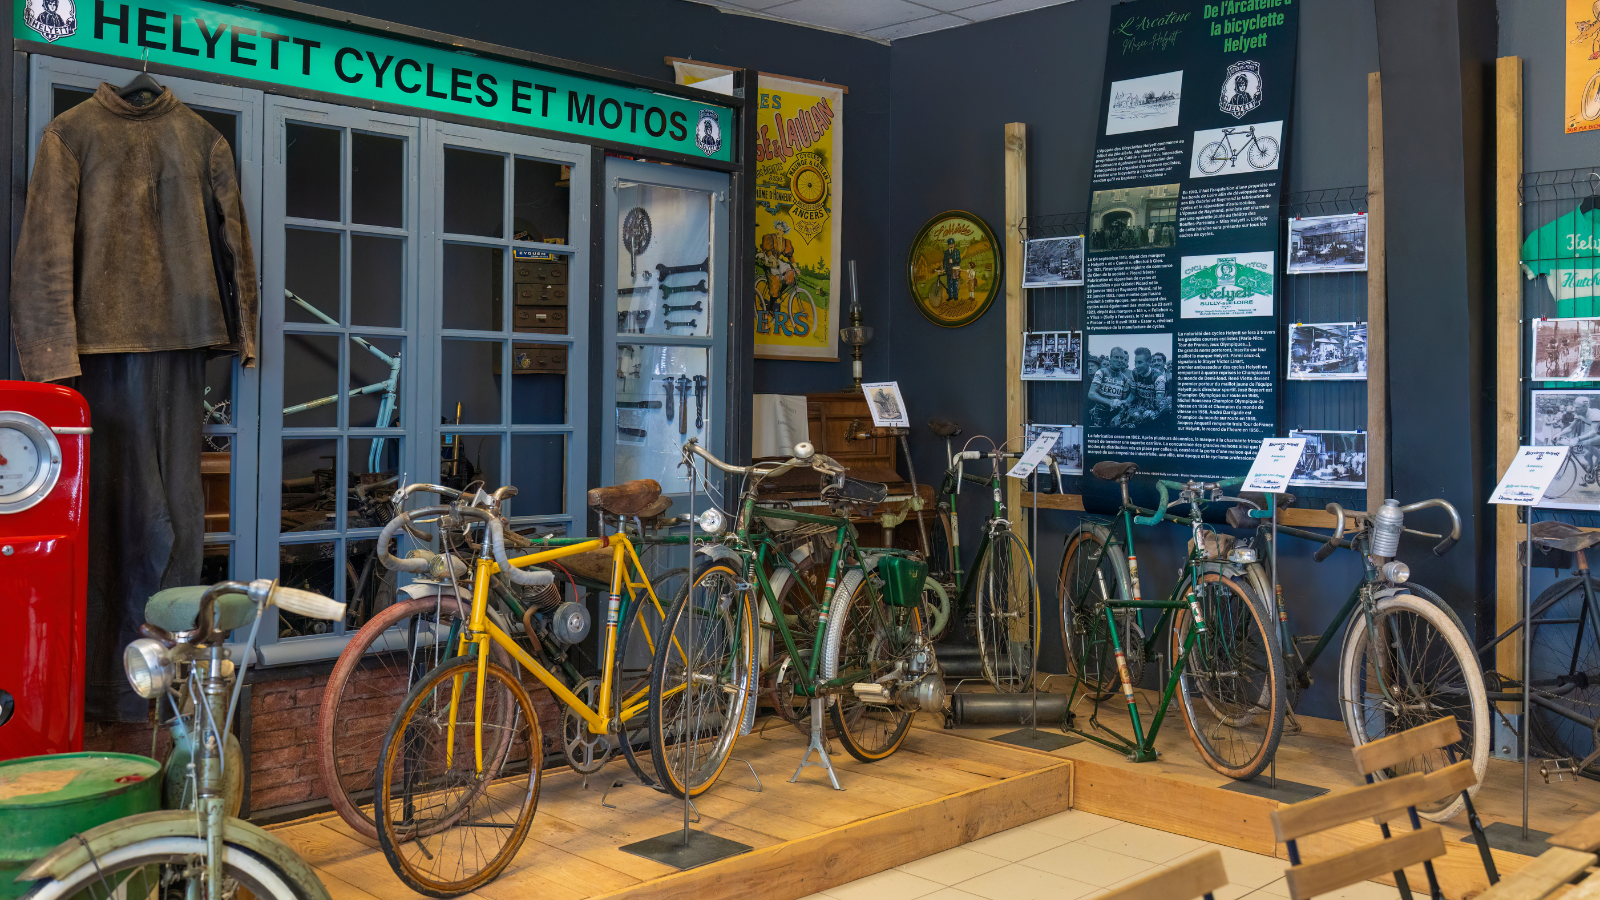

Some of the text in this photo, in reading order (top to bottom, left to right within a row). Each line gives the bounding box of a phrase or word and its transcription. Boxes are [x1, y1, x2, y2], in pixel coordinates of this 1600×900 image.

[1203, 4, 1219, 19] De
[32, 20, 68, 34] HELYETT
[1210, 12, 1285, 36] la bicyclette
[1223, 32, 1268, 54] Helyett
[94, 0, 688, 142] HELYETT CYCLES ET MOTOS
[759, 93, 782, 110] ES
[1224, 100, 1257, 112] HELYETT
[775, 96, 834, 158] LAULAN
[792, 207, 824, 220] ANGERS
[1199, 286, 1255, 302] Helyett
[756, 310, 811, 338] ERS
